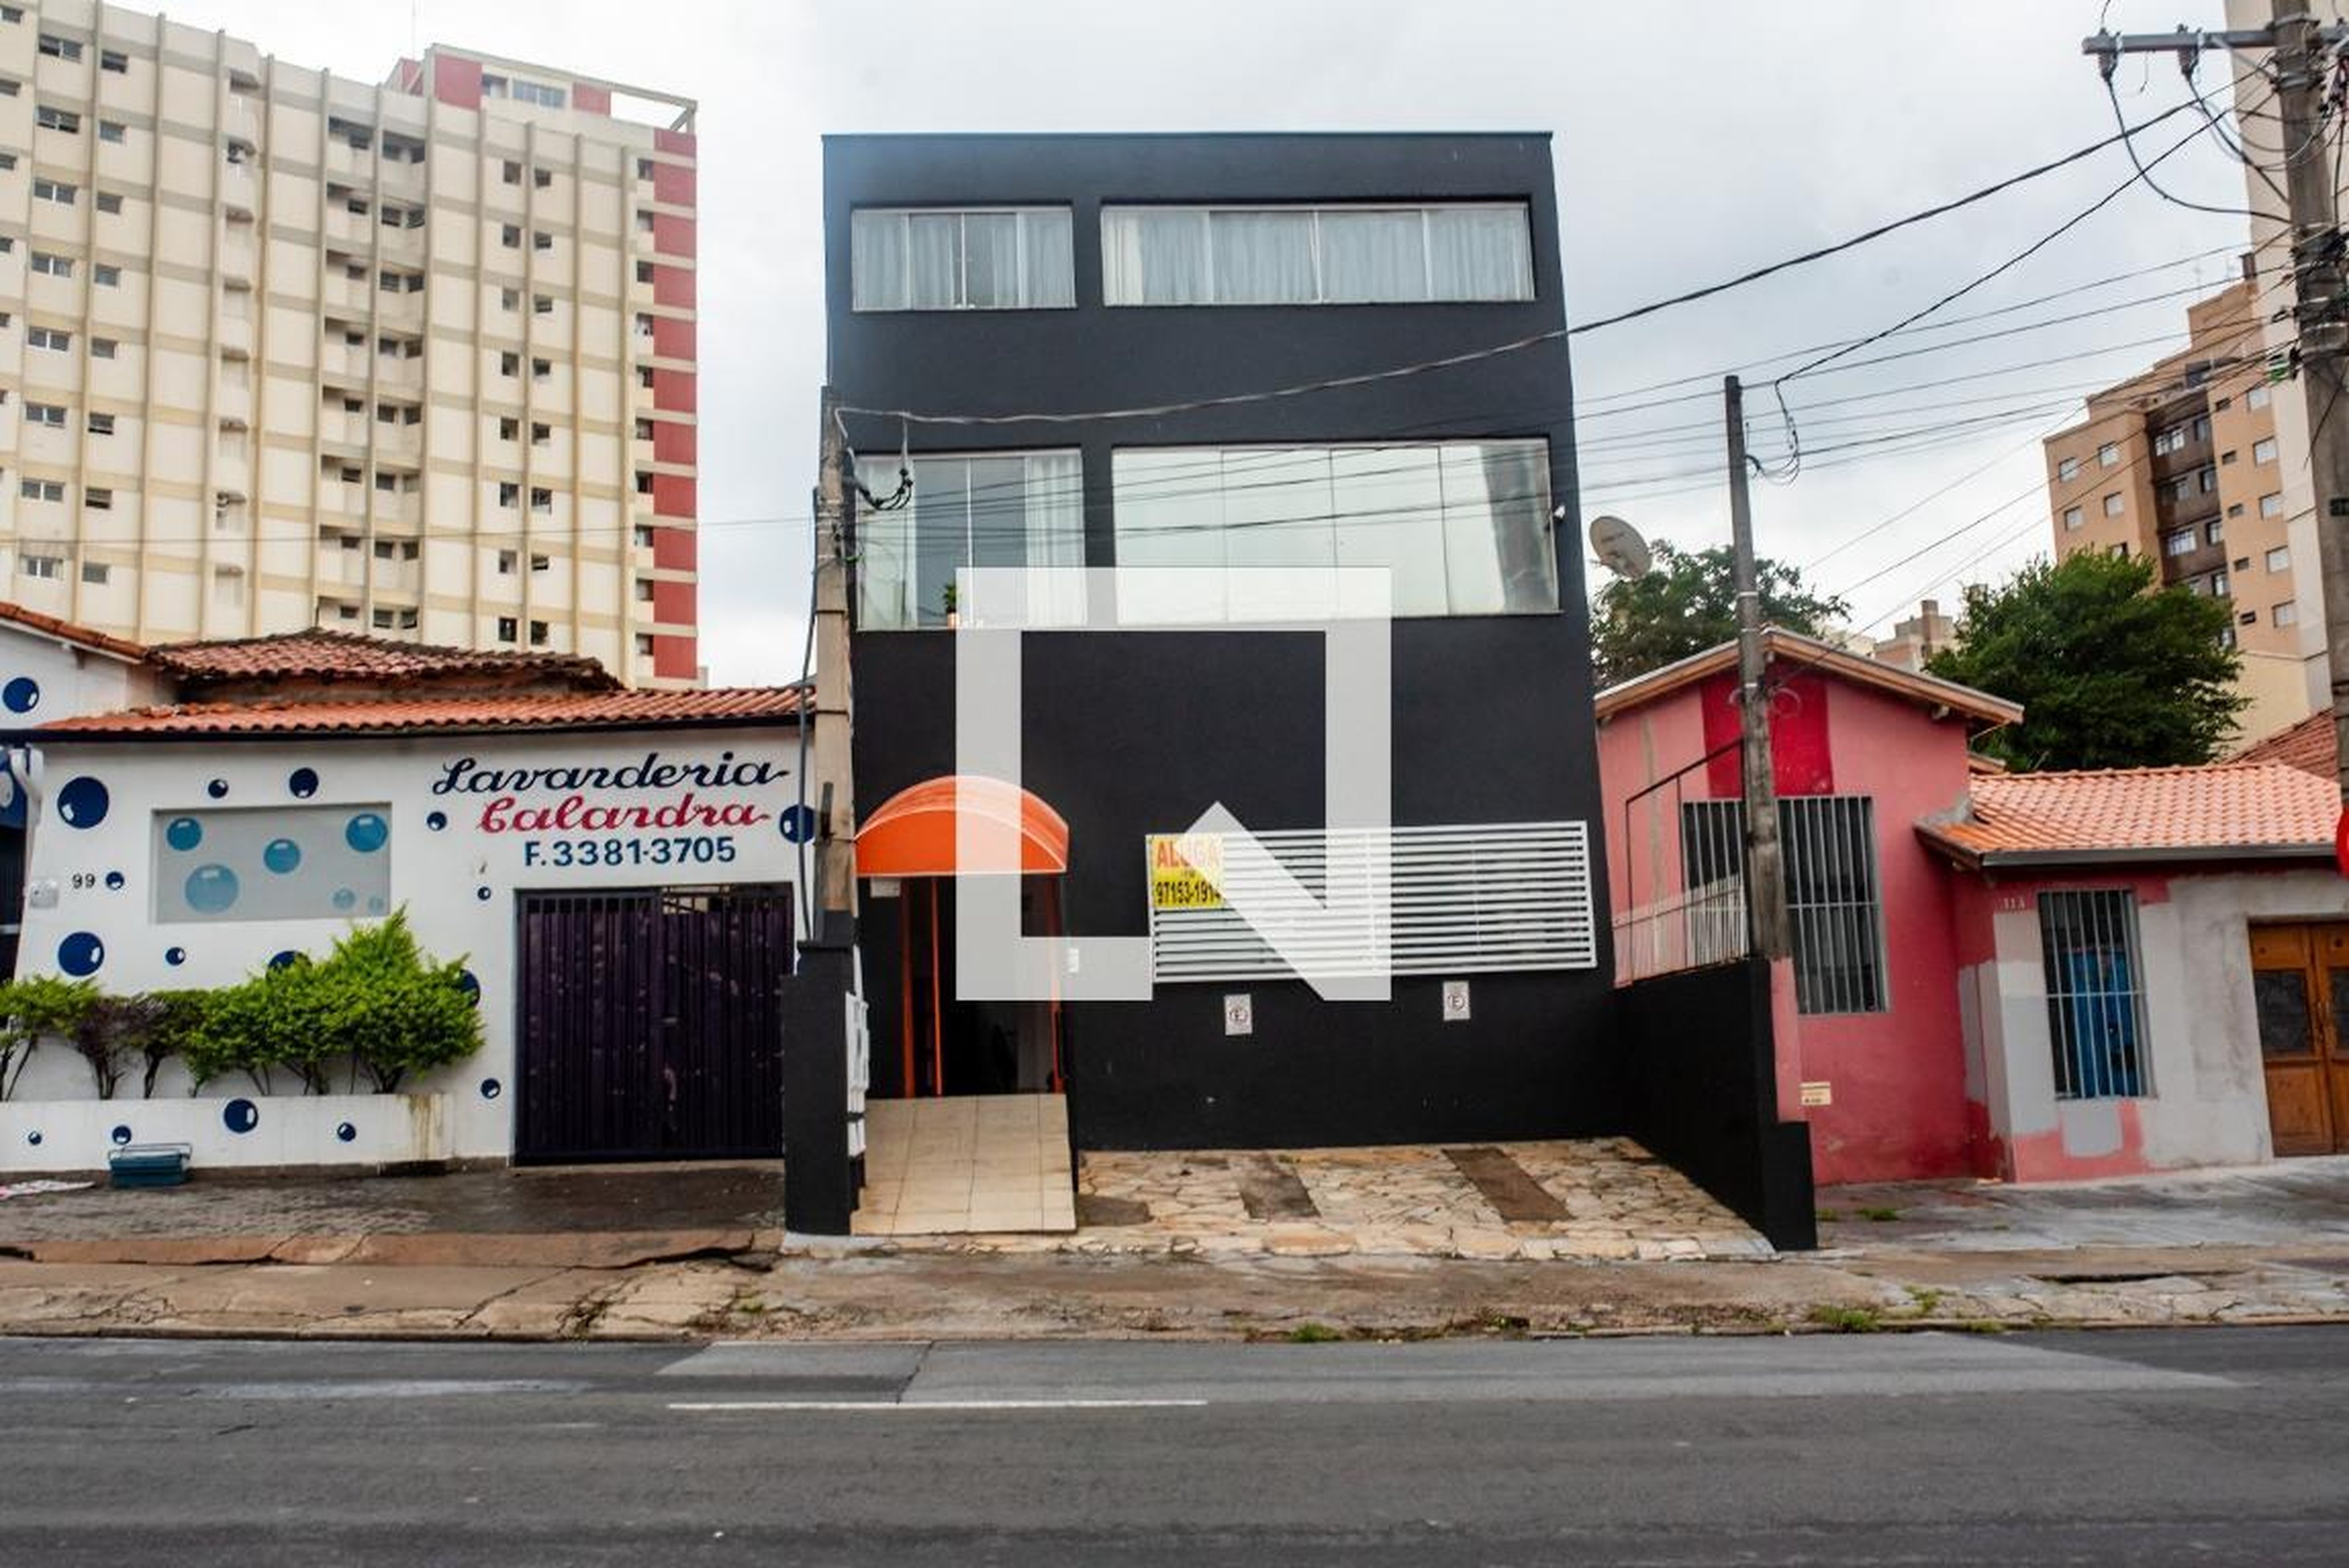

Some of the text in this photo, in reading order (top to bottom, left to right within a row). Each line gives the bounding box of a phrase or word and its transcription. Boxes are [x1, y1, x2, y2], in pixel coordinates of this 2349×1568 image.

[432, 752, 790, 795] Lavanderia
[477, 793, 771, 833] Calandra
[72, 873, 96, 889] 99
